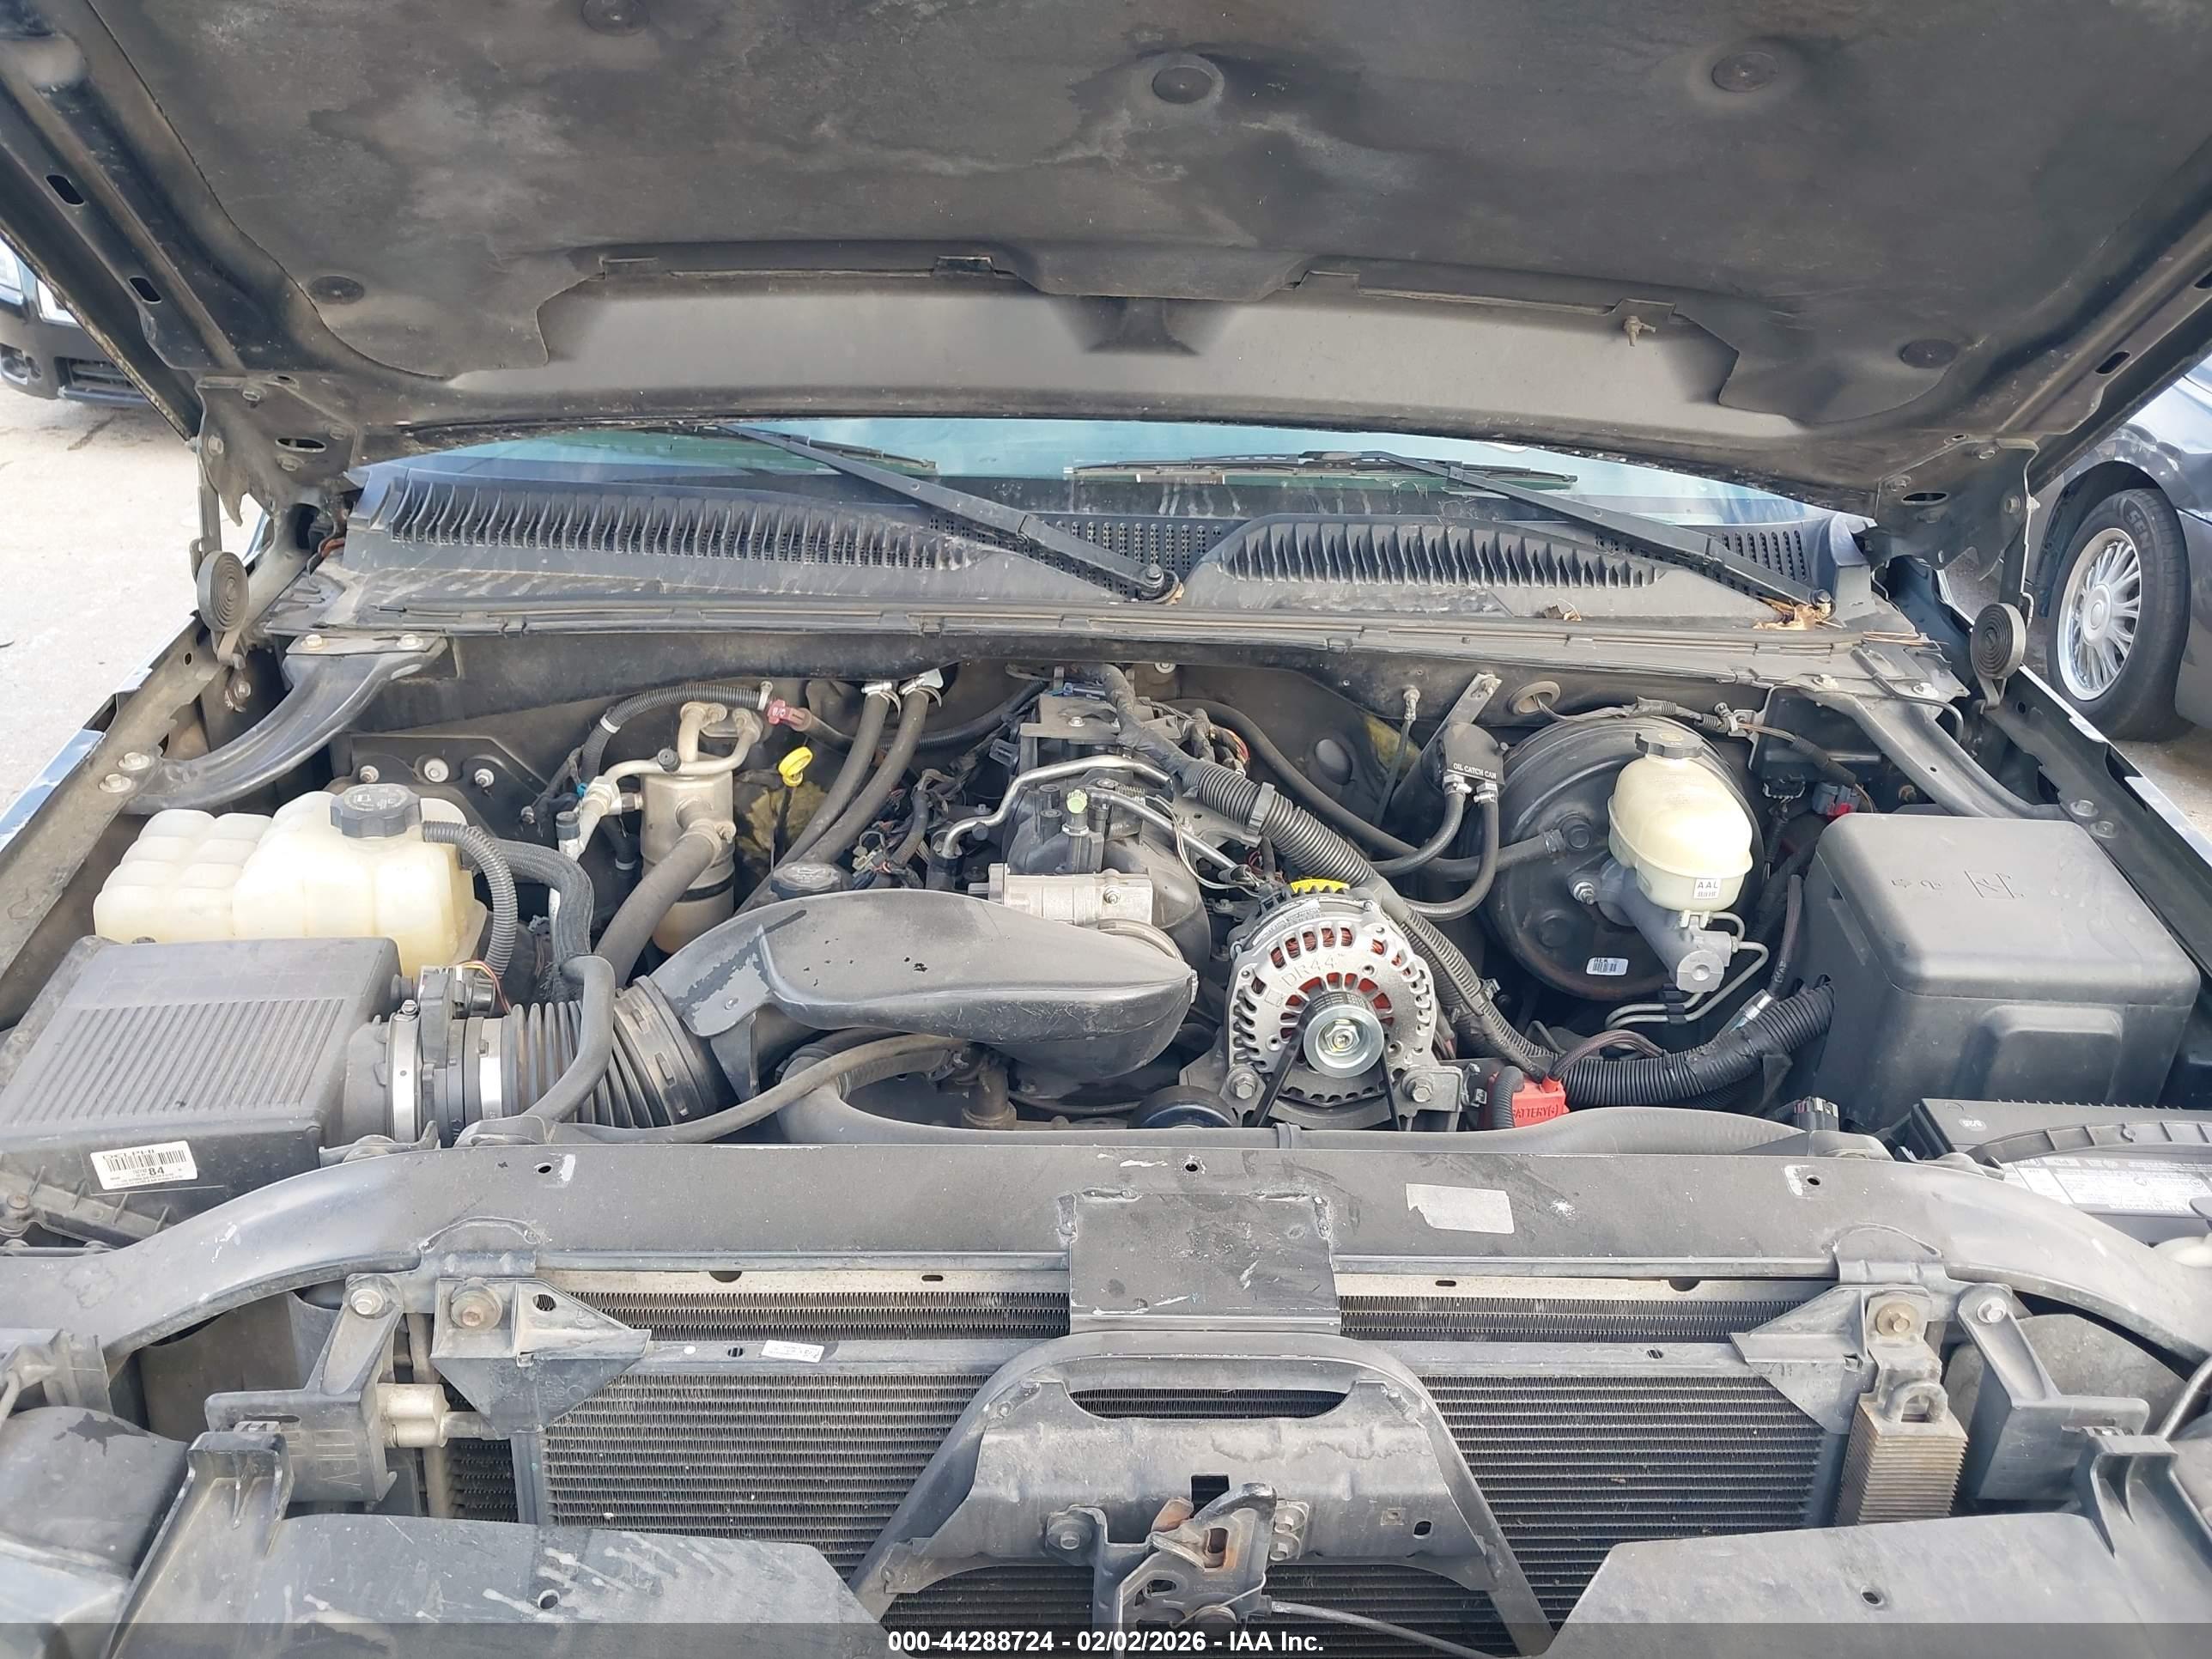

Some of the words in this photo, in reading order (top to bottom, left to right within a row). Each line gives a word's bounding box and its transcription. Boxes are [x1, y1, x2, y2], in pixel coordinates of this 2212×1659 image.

[1453, 763, 1464, 771] OIL
[1464, 765, 1484, 777] CATCH
[1484, 769, 1497, 779] CAN
[149, 1166, 165, 1176] 84
